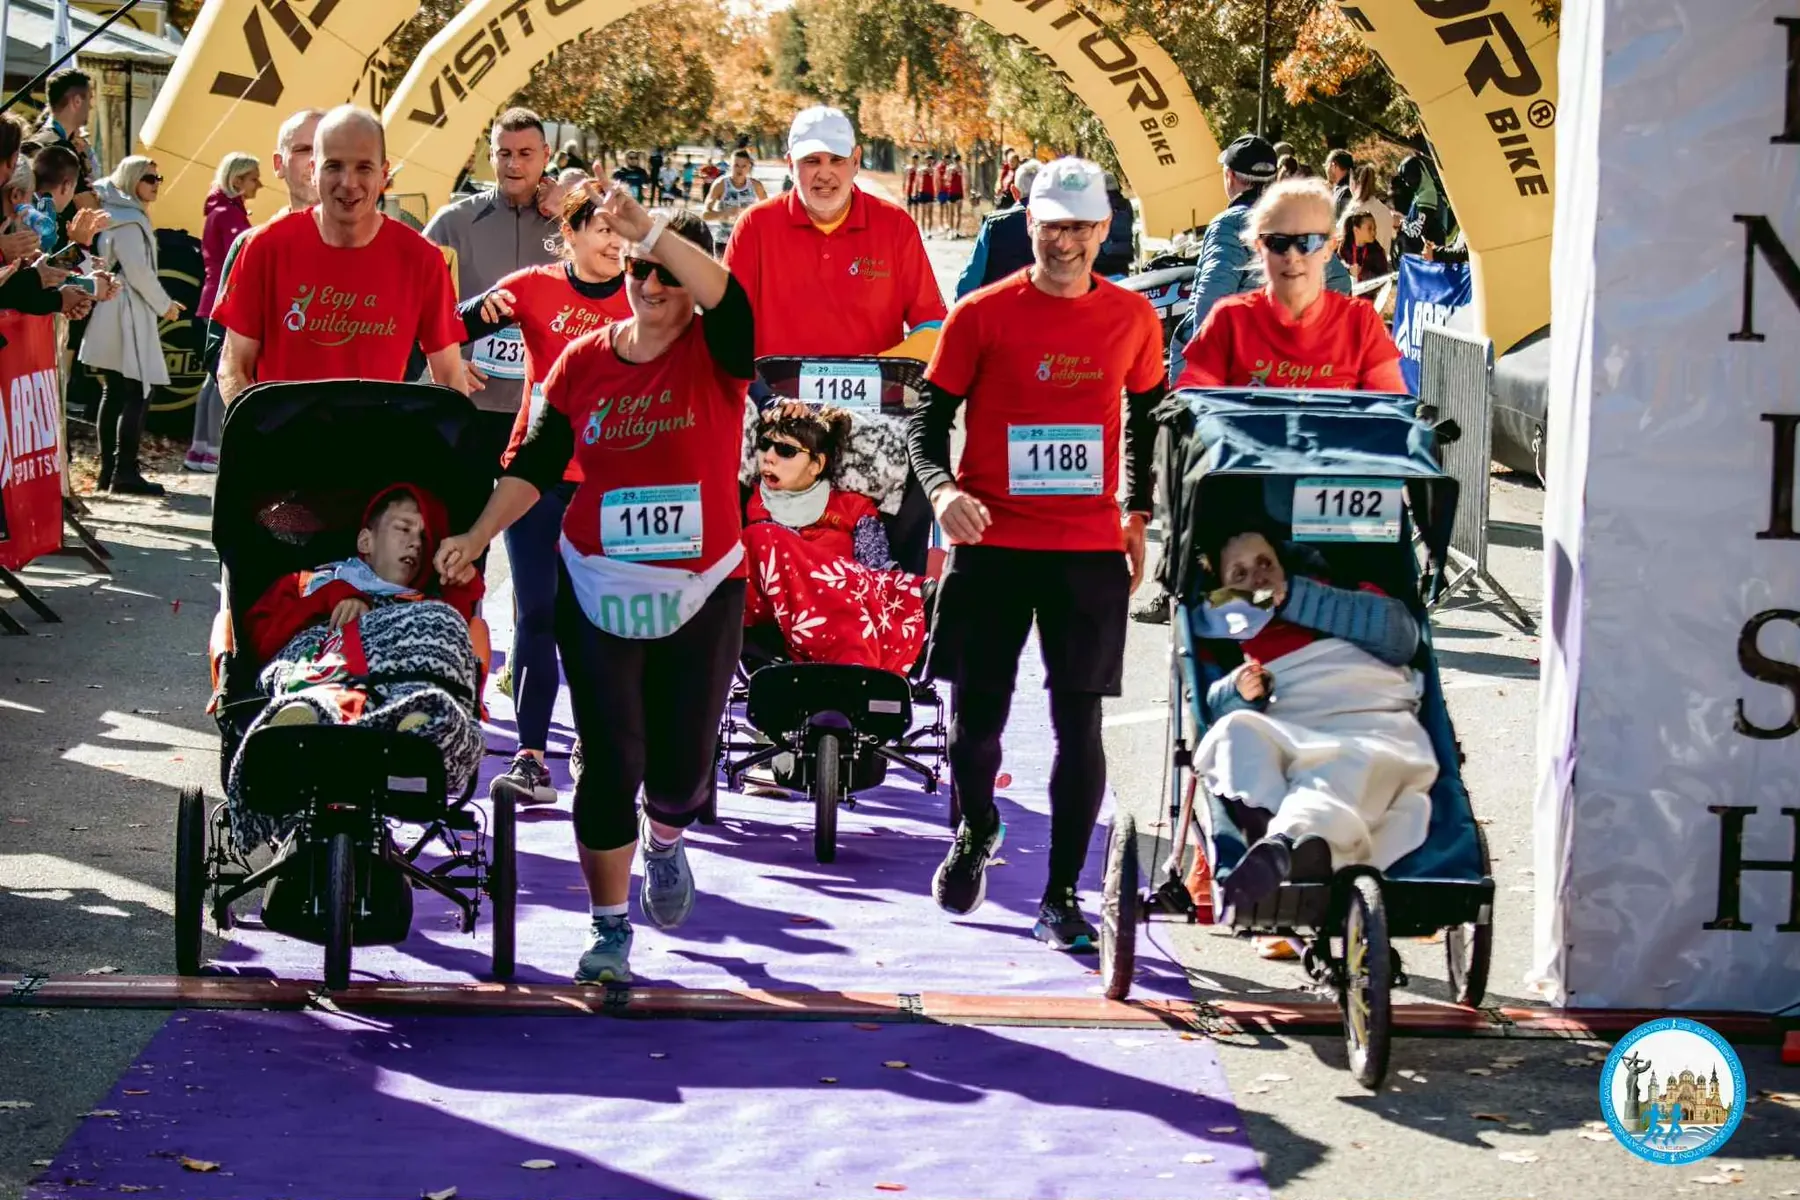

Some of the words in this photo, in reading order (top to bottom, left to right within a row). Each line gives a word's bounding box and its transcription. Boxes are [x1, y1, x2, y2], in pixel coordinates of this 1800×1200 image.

[1140, 116, 1176, 166] BIKE
[1485, 107, 1549, 197] BIKE
[320, 286, 357, 311] Egy
[364, 294, 377, 307] a
[309, 312, 396, 346] világunk
[1277, 361, 1313, 383] Egy
[1321, 364, 1334, 377] a
[618, 395, 653, 415] Egy
[660, 389, 672, 403] a
[815, 378, 866, 400] 1184
[605, 406, 695, 450] világunk
[1028, 444, 1087, 471] 1188
[1316, 489, 1382, 517] 1182
[620, 505, 683, 536] 1187
